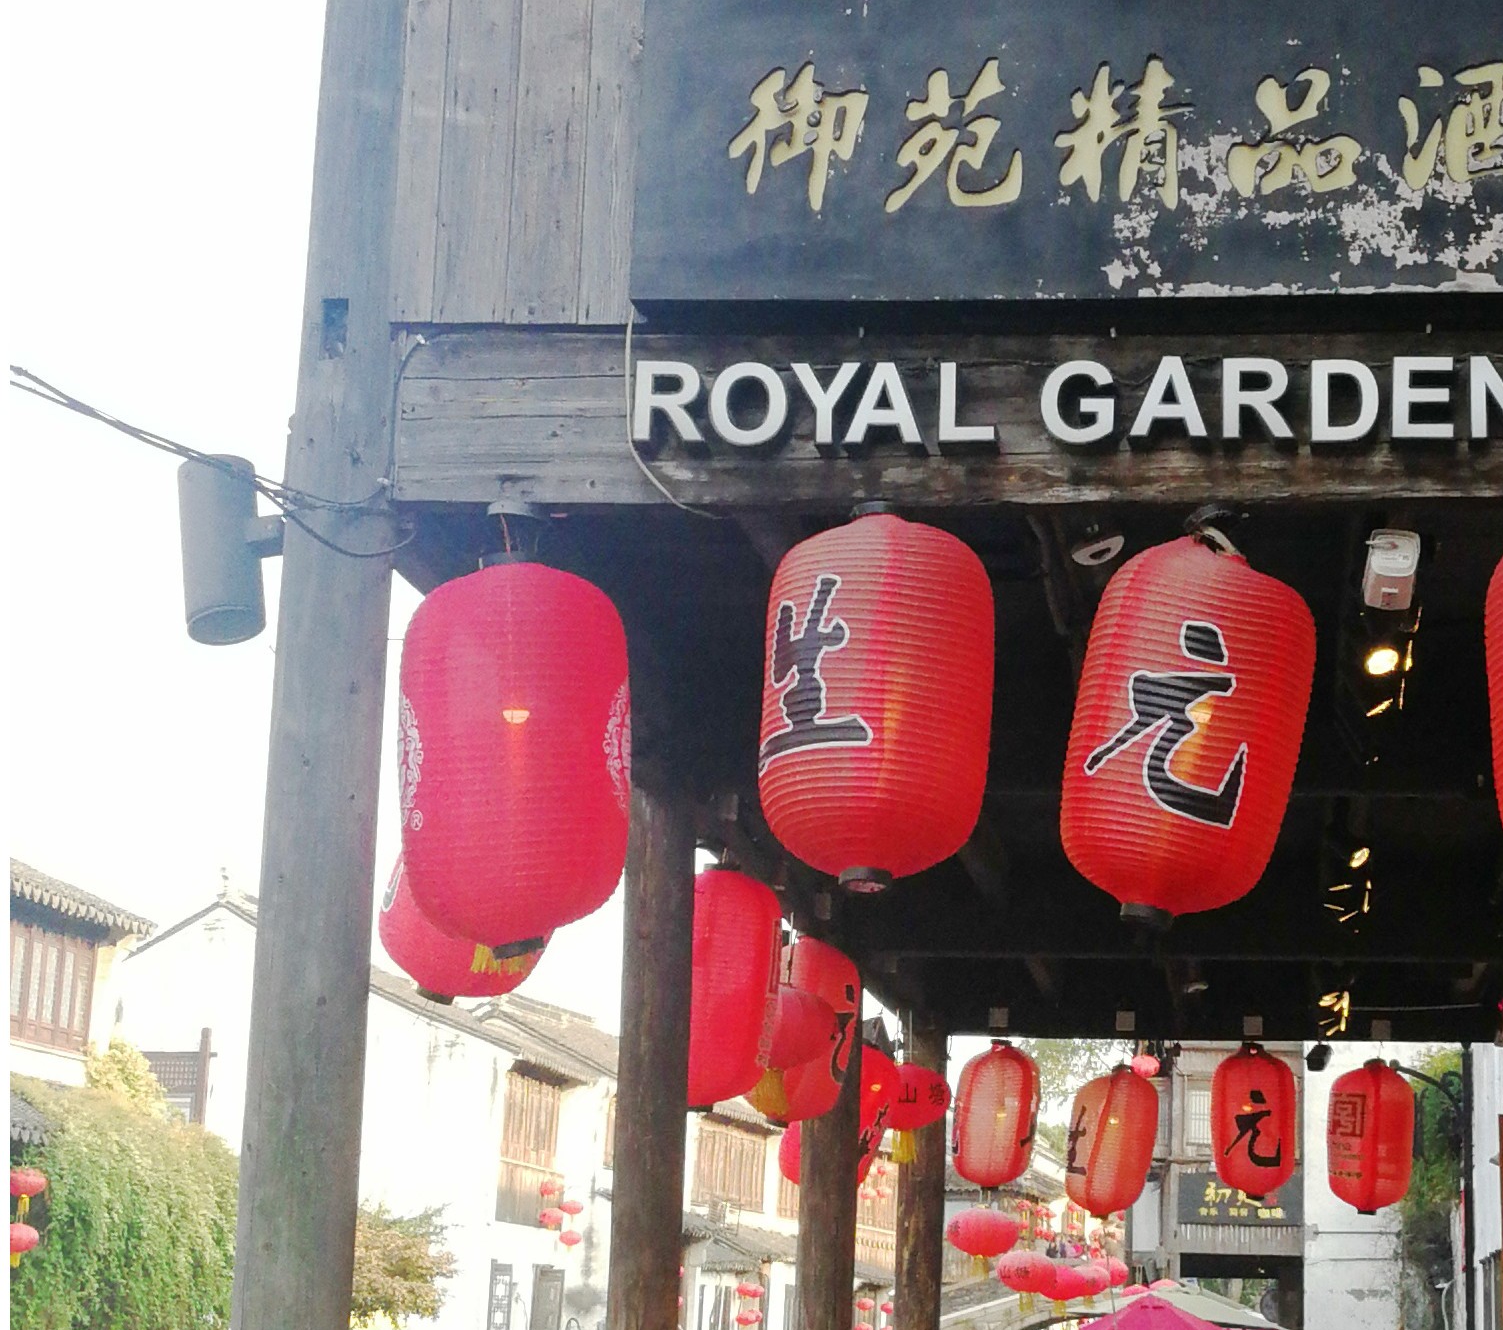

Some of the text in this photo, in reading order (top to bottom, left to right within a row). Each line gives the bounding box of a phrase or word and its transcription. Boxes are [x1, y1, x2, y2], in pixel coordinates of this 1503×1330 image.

[632, 359, 995, 445] ROYAL
[759, 574, 873, 777] 生
[1084, 620, 1248, 829] 元
[899, 1081, 946, 1106] 山塘
[1224, 1090, 1282, 1167] 元
